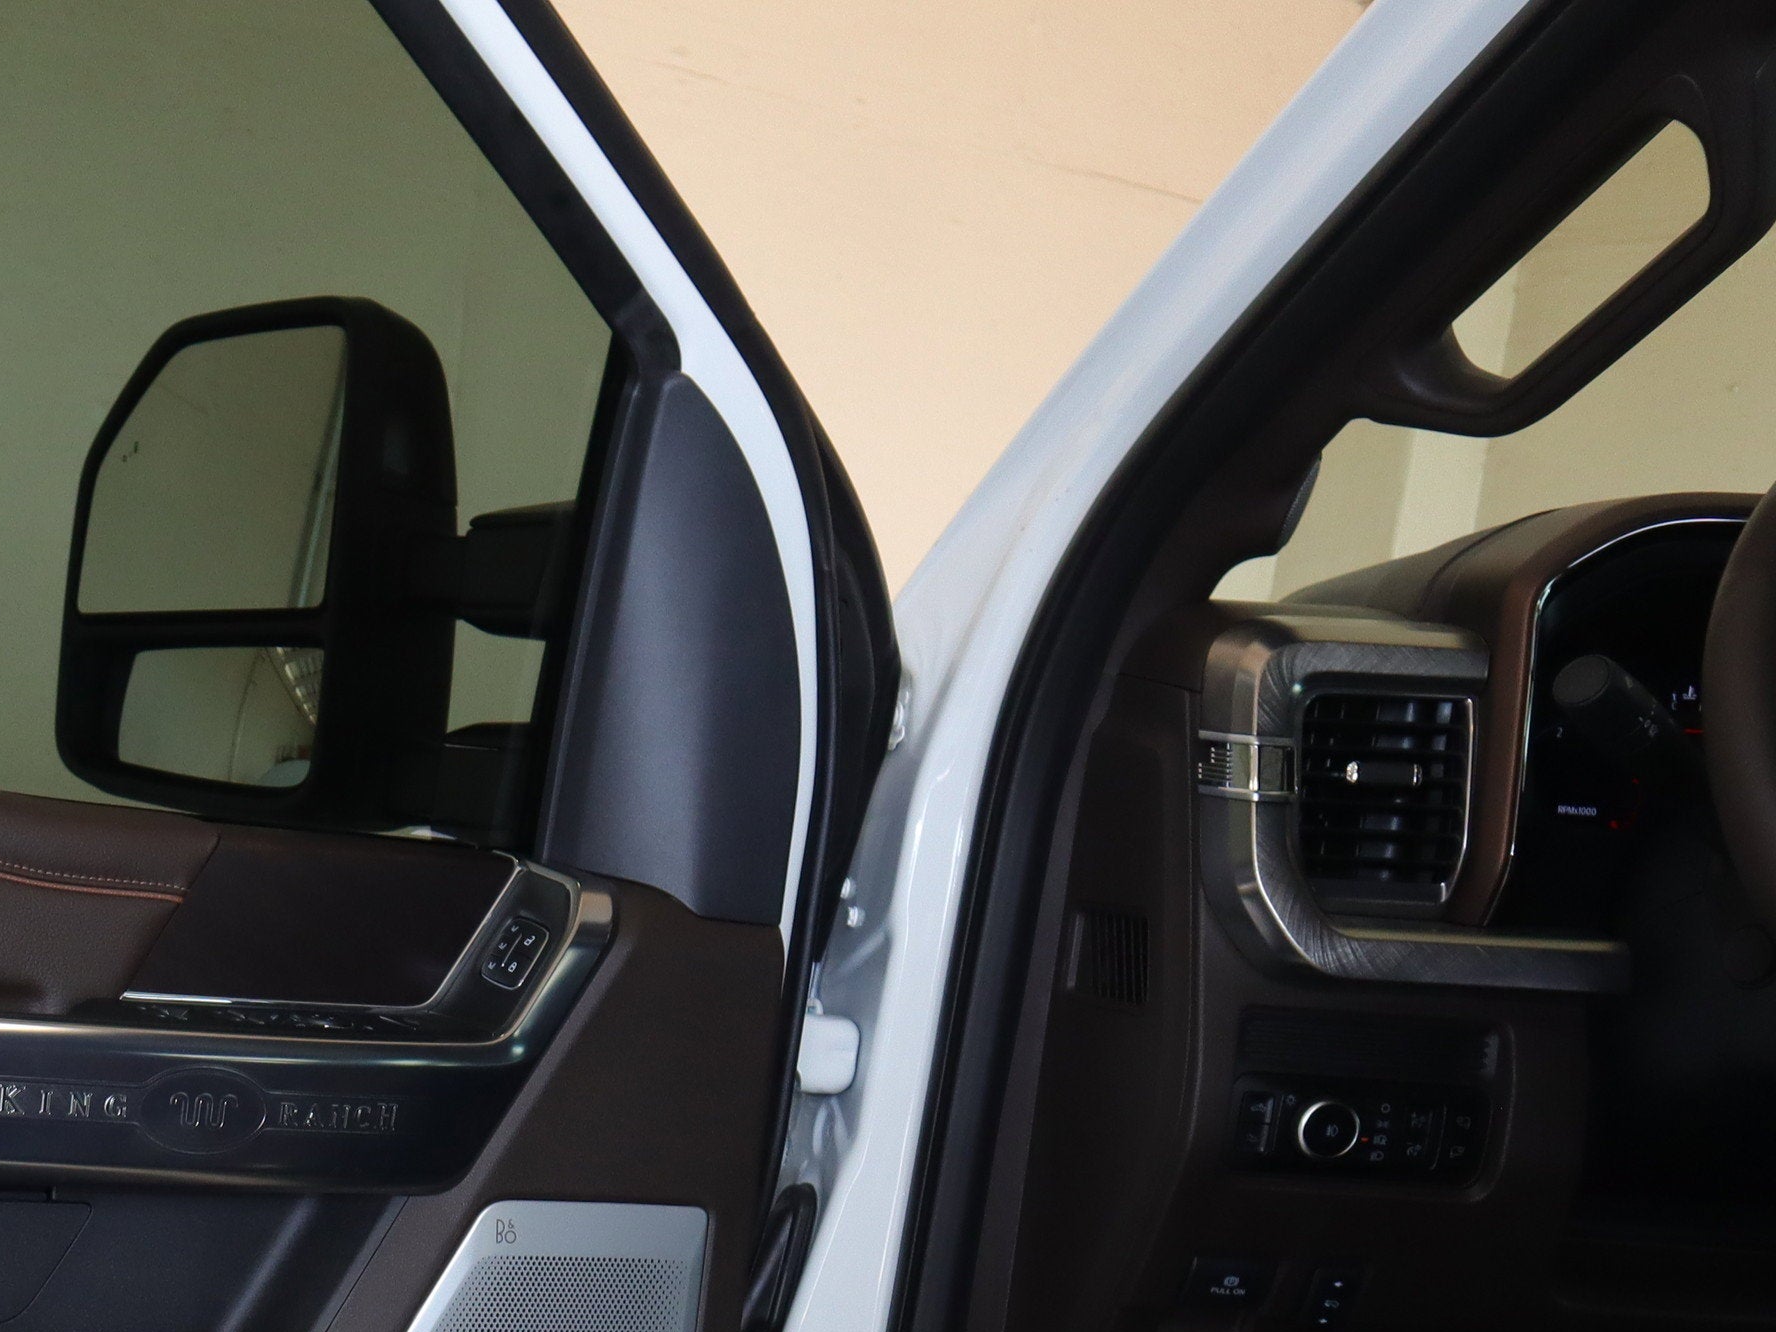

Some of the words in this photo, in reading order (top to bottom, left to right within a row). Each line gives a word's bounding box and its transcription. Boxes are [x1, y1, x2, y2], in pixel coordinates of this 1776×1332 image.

[279, 1101, 399, 1131] RANCH
[1210, 1286, 1232, 1296] PULL
[1233, 1287, 1246, 1297] ON
